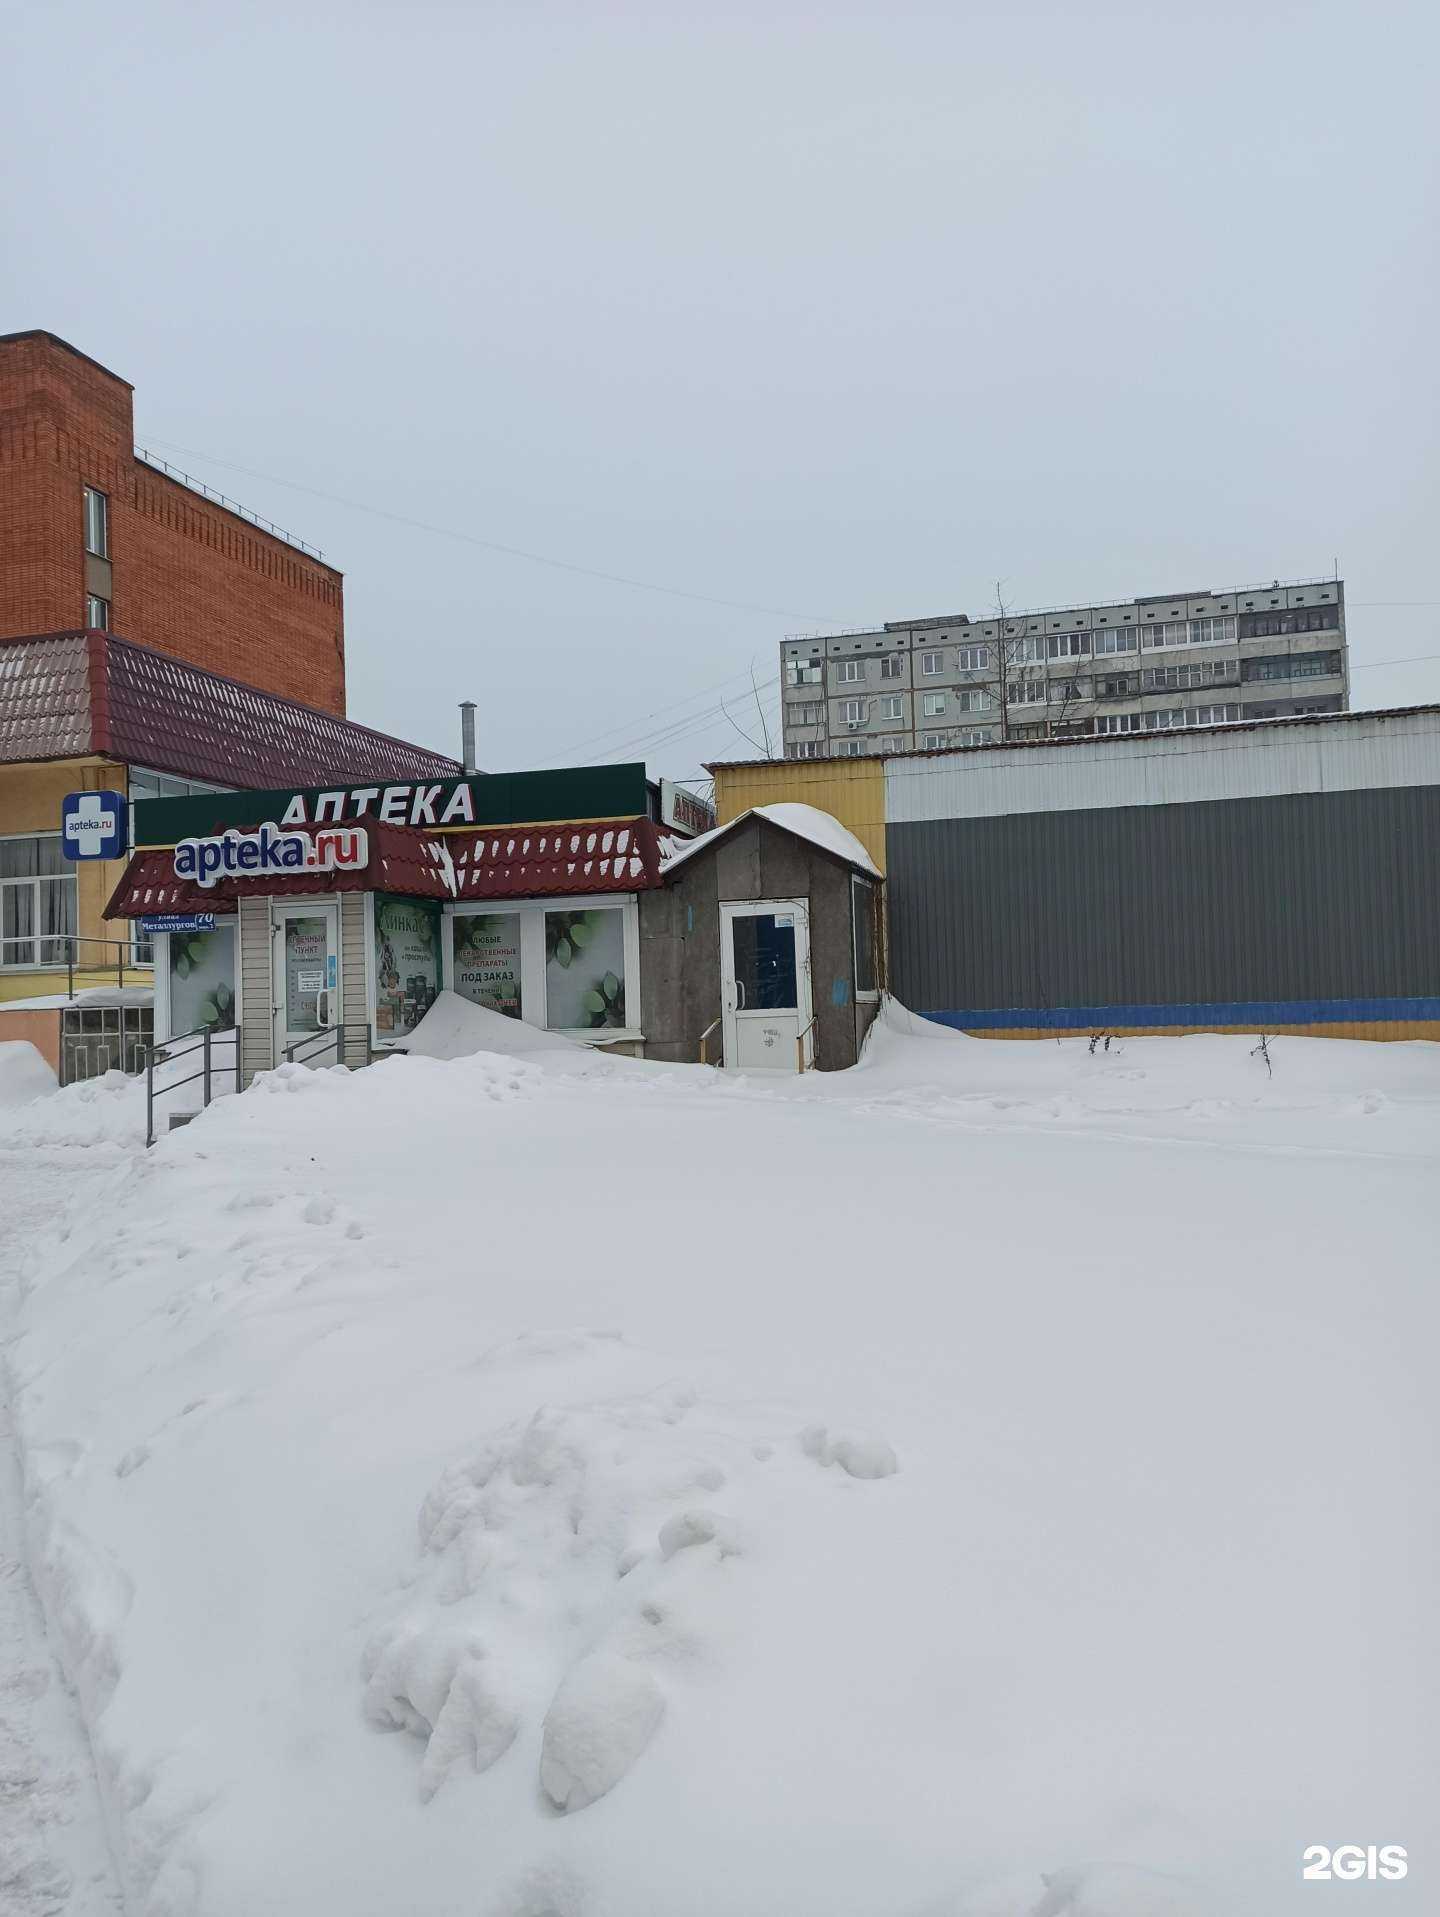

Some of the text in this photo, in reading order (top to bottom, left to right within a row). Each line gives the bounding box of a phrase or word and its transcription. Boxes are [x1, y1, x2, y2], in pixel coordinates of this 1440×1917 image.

[281, 783, 476, 826] АПТЕКА
[68, 819, 112, 832] apteka.ru
[175, 827, 359, 882] apteka.ru
[198, 912, 214, 923] 70
[143, 922, 195, 931] Металлургов
[473, 936, 502, 944] ЛЮБЫЕ
[461, 972, 514, 984] ПОД ЗАКАЗ
